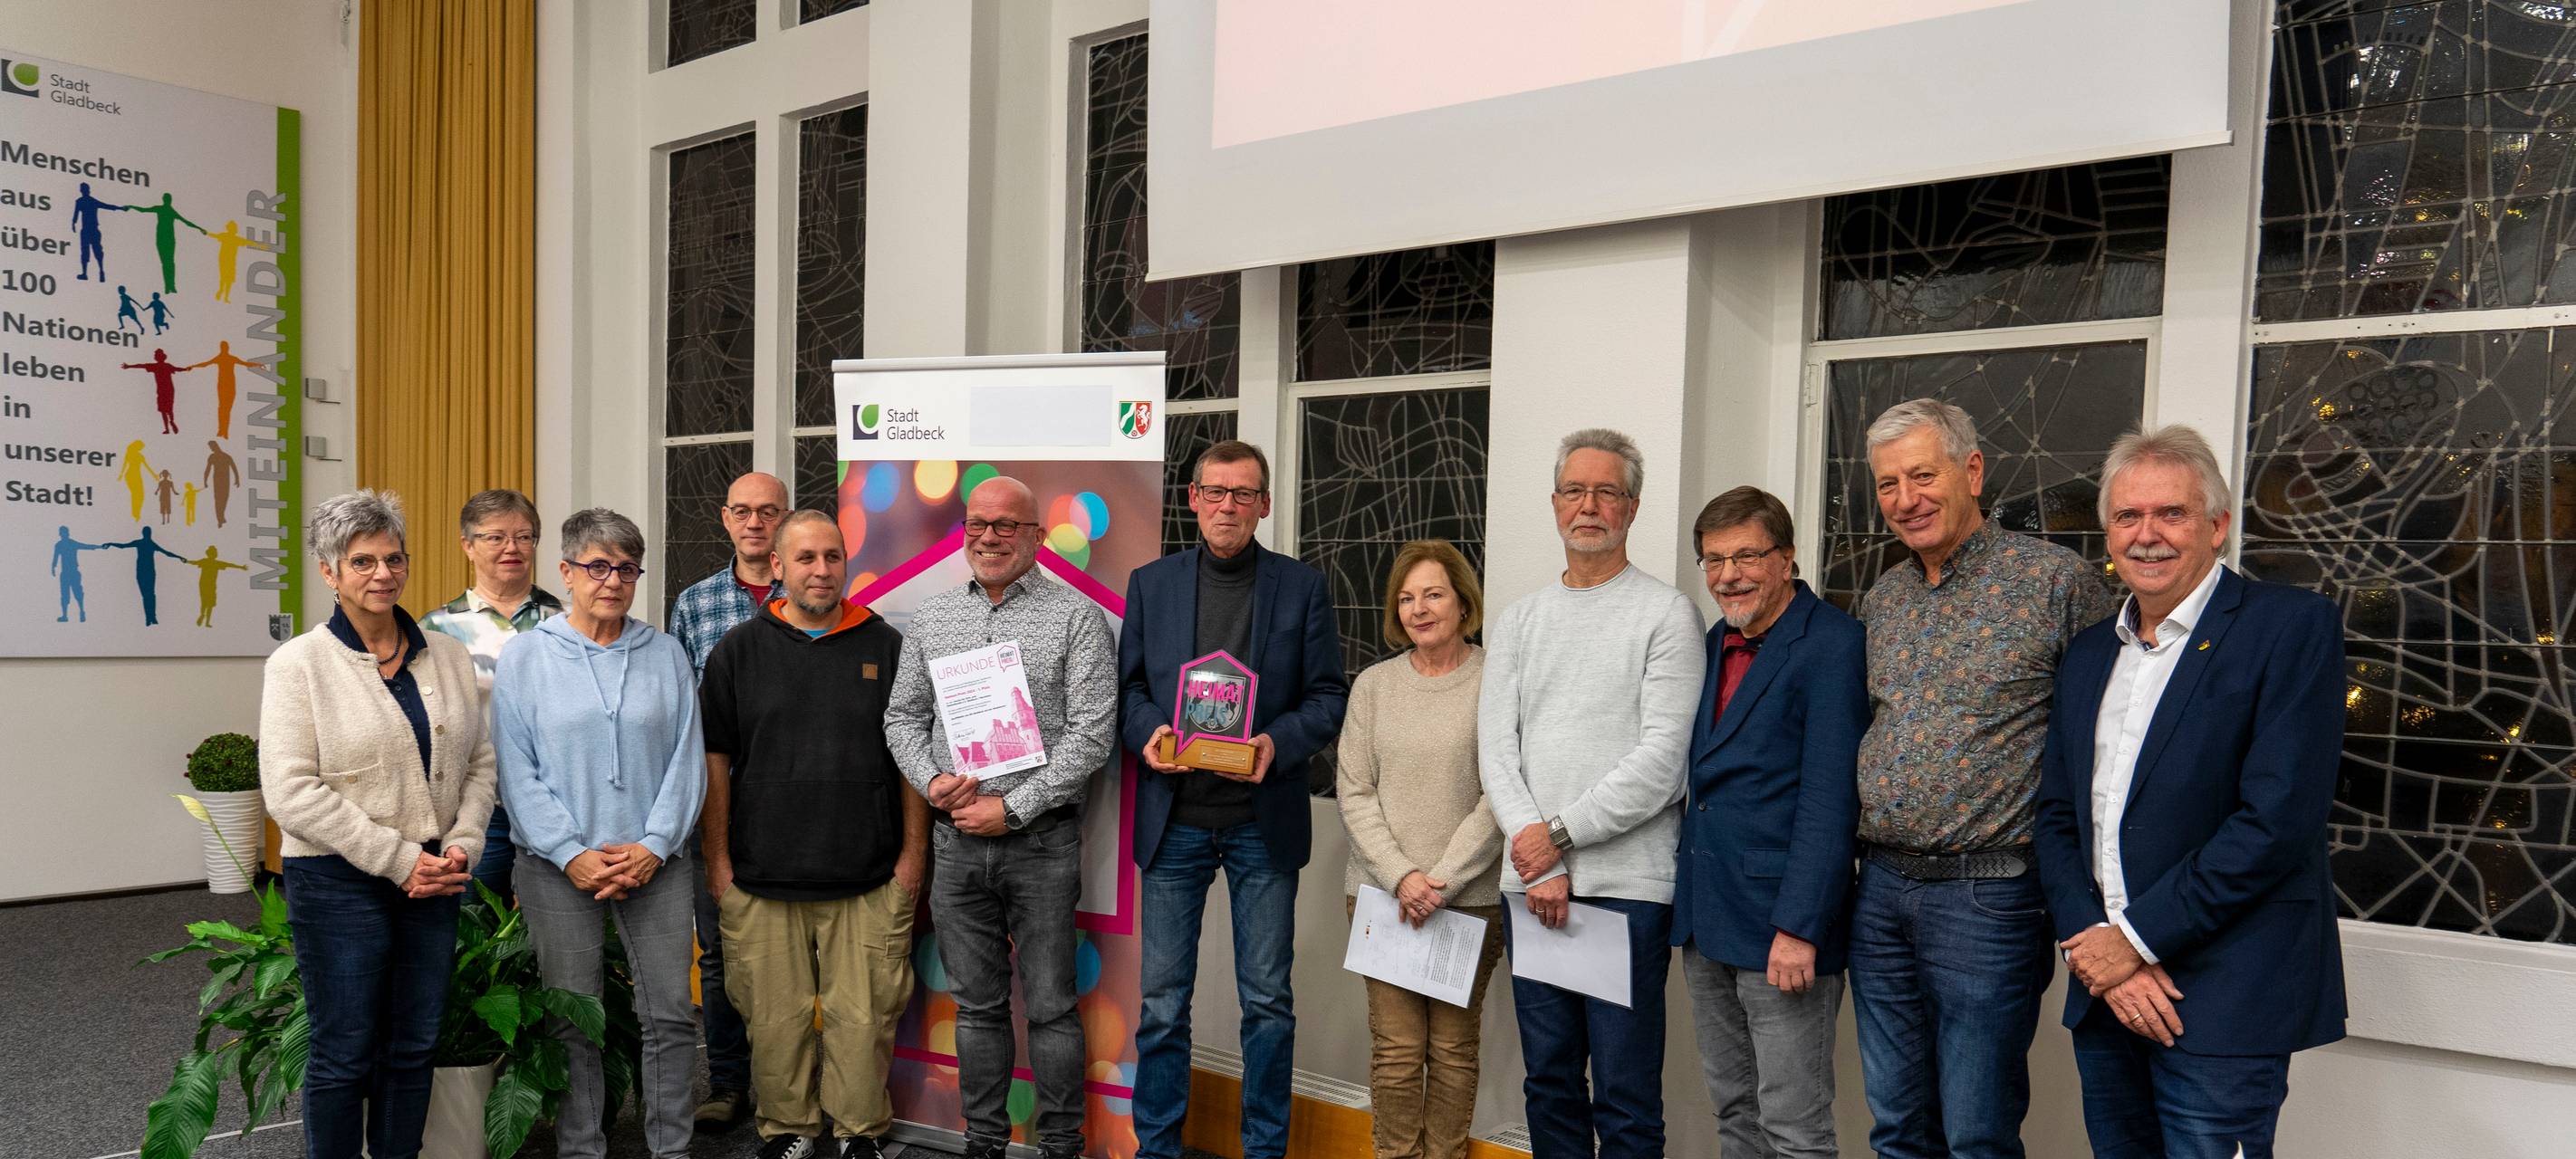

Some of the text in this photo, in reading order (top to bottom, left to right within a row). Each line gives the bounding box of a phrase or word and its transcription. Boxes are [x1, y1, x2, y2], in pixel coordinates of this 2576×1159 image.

[51, 74, 90, 93] Stadt
[51, 91, 121, 116] Gladbeck
[1, 140, 149, 187] Menschen
[0, 188, 52, 211] aus
[2, 226, 71, 255] über
[3, 269, 56, 296] 100
[3, 311, 139, 348] Nationen
[4, 352, 85, 382] leben
[246, 189, 289, 590] MITEINANDER
[5, 395, 31, 418] in
[887, 408, 919, 423] Stadt
[887, 426, 945, 440] Gladbeck
[5, 443, 116, 466] unserer
[5, 481, 93, 506] Stadt!
[937, 656, 995, 680] URKUNDE
[1187, 680, 1244, 704] HEIMAT
[1185, 703, 1228, 724] PREIS
